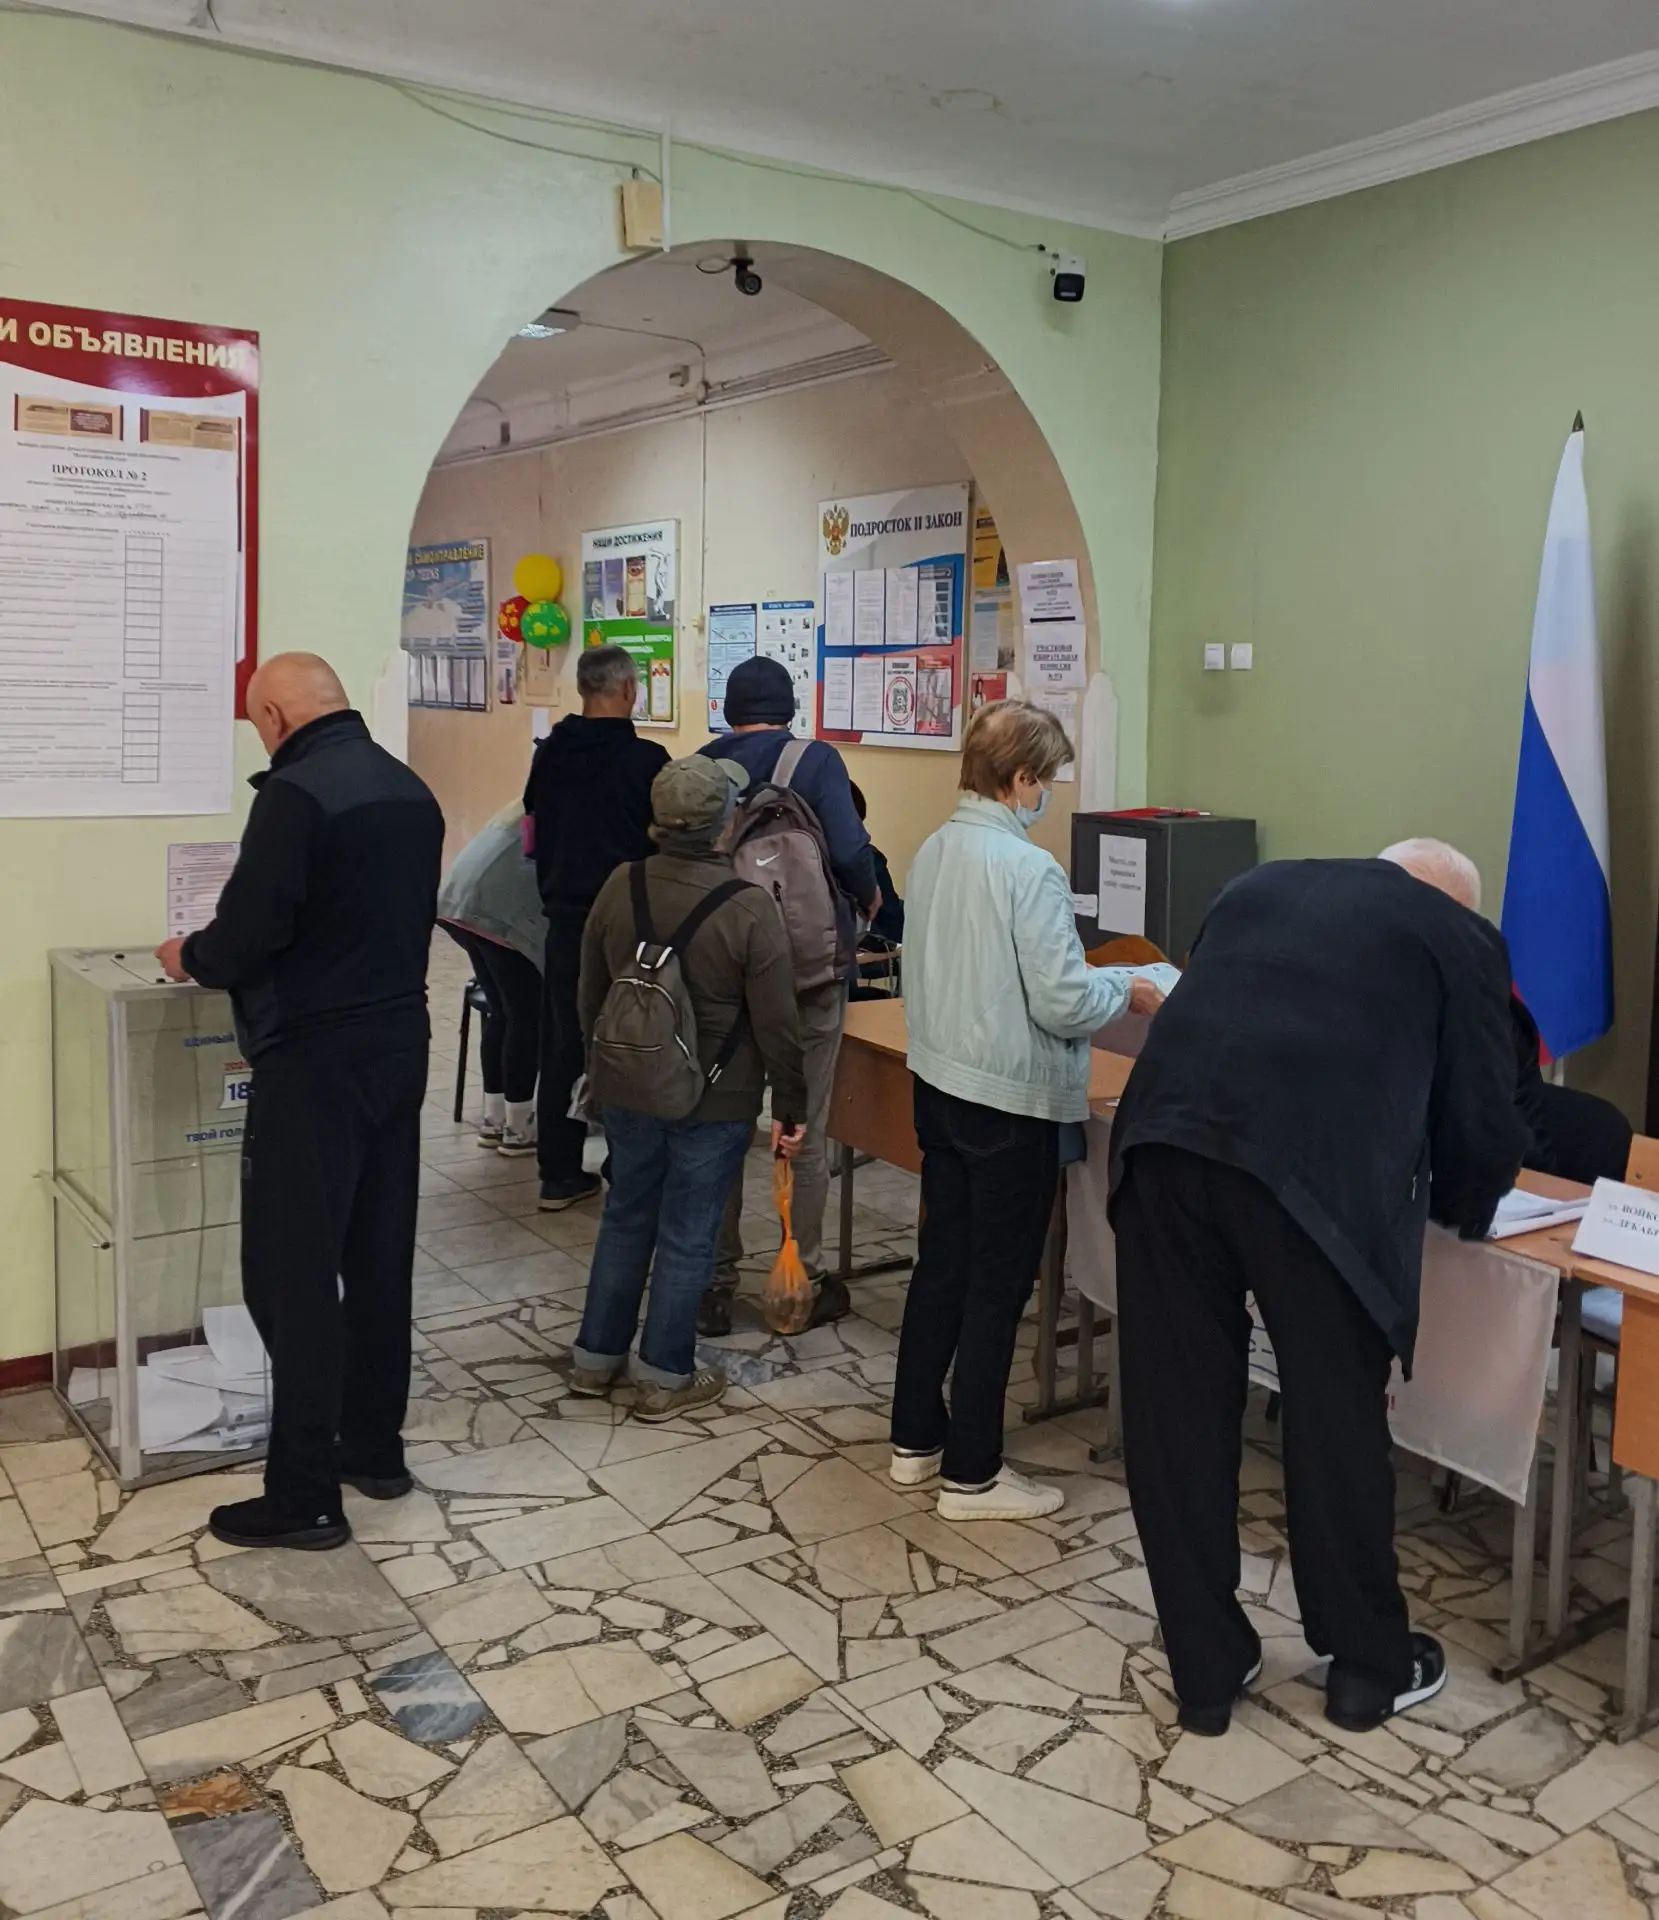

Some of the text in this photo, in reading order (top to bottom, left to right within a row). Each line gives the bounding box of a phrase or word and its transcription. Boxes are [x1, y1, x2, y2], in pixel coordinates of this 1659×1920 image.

[0, 316, 246, 371] И ОБЪЯВЛЕНИЯ
[51, 463, 123, 480] ПРОТОКОЛ
[141, 471, 147, 482] 2
[850, 516, 912, 538] ПОДРОСТОК
[914, 515, 922, 531] И
[924, 511, 962, 530] ЗАКОН
[614, 530, 663, 547] ДОСТИЖЕНИЯ
[185, 1127, 243, 1142] ТВОЙ ГОЛ
